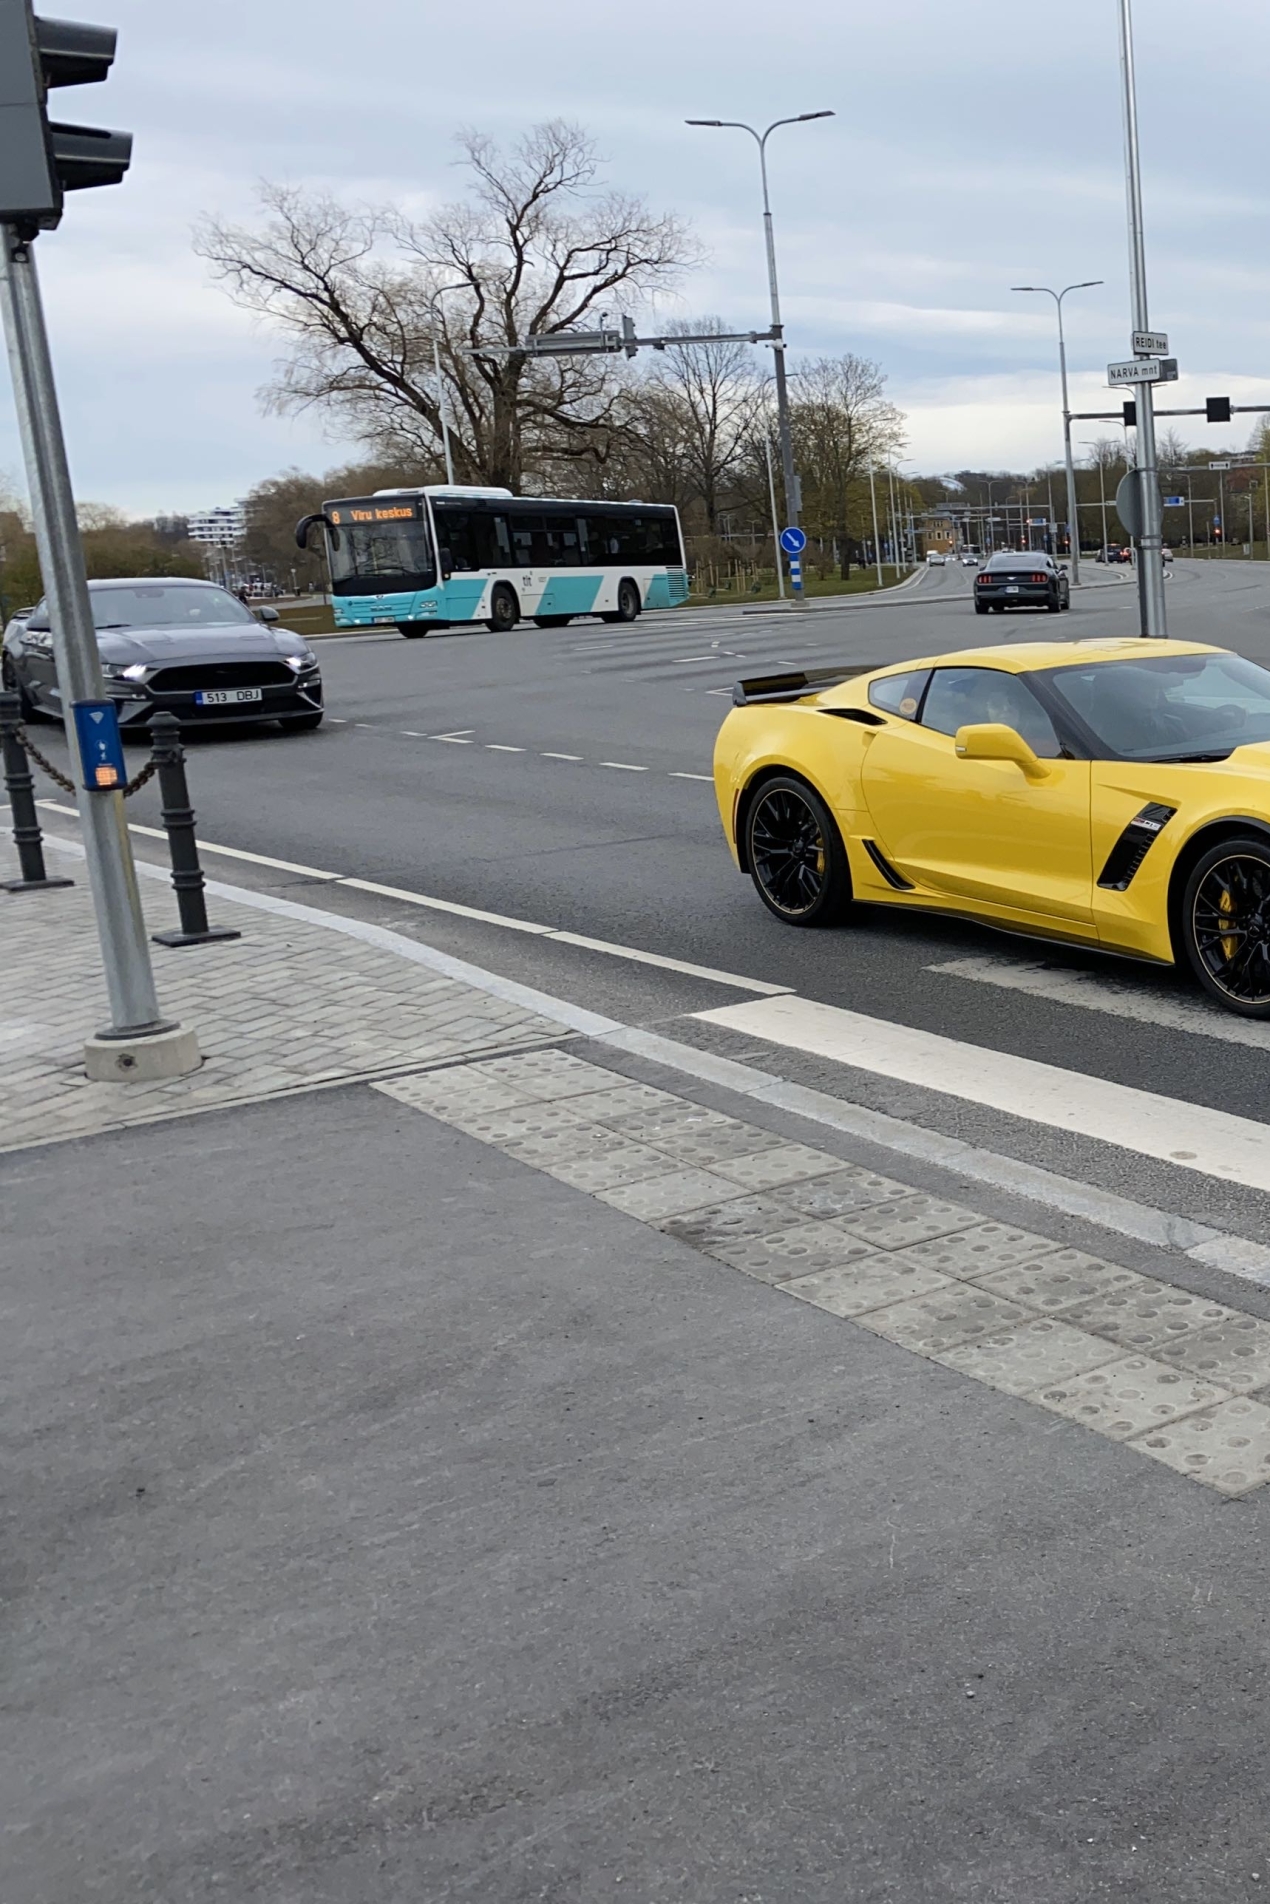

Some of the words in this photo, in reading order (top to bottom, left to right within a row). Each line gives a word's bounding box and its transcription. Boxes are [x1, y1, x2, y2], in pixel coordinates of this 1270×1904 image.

[1136, 337, 1155, 348] REIDI
[1156, 340, 1166, 349] tee
[1111, 367, 1139, 379] NARVA
[1142, 365, 1157, 375] mnt
[331, 510, 341, 525] 8
[350, 509, 372, 521] Viru
[375, 506, 413, 520] keskus
[207, 693, 227, 703] 513
[237, 690, 259, 701] DBJ
